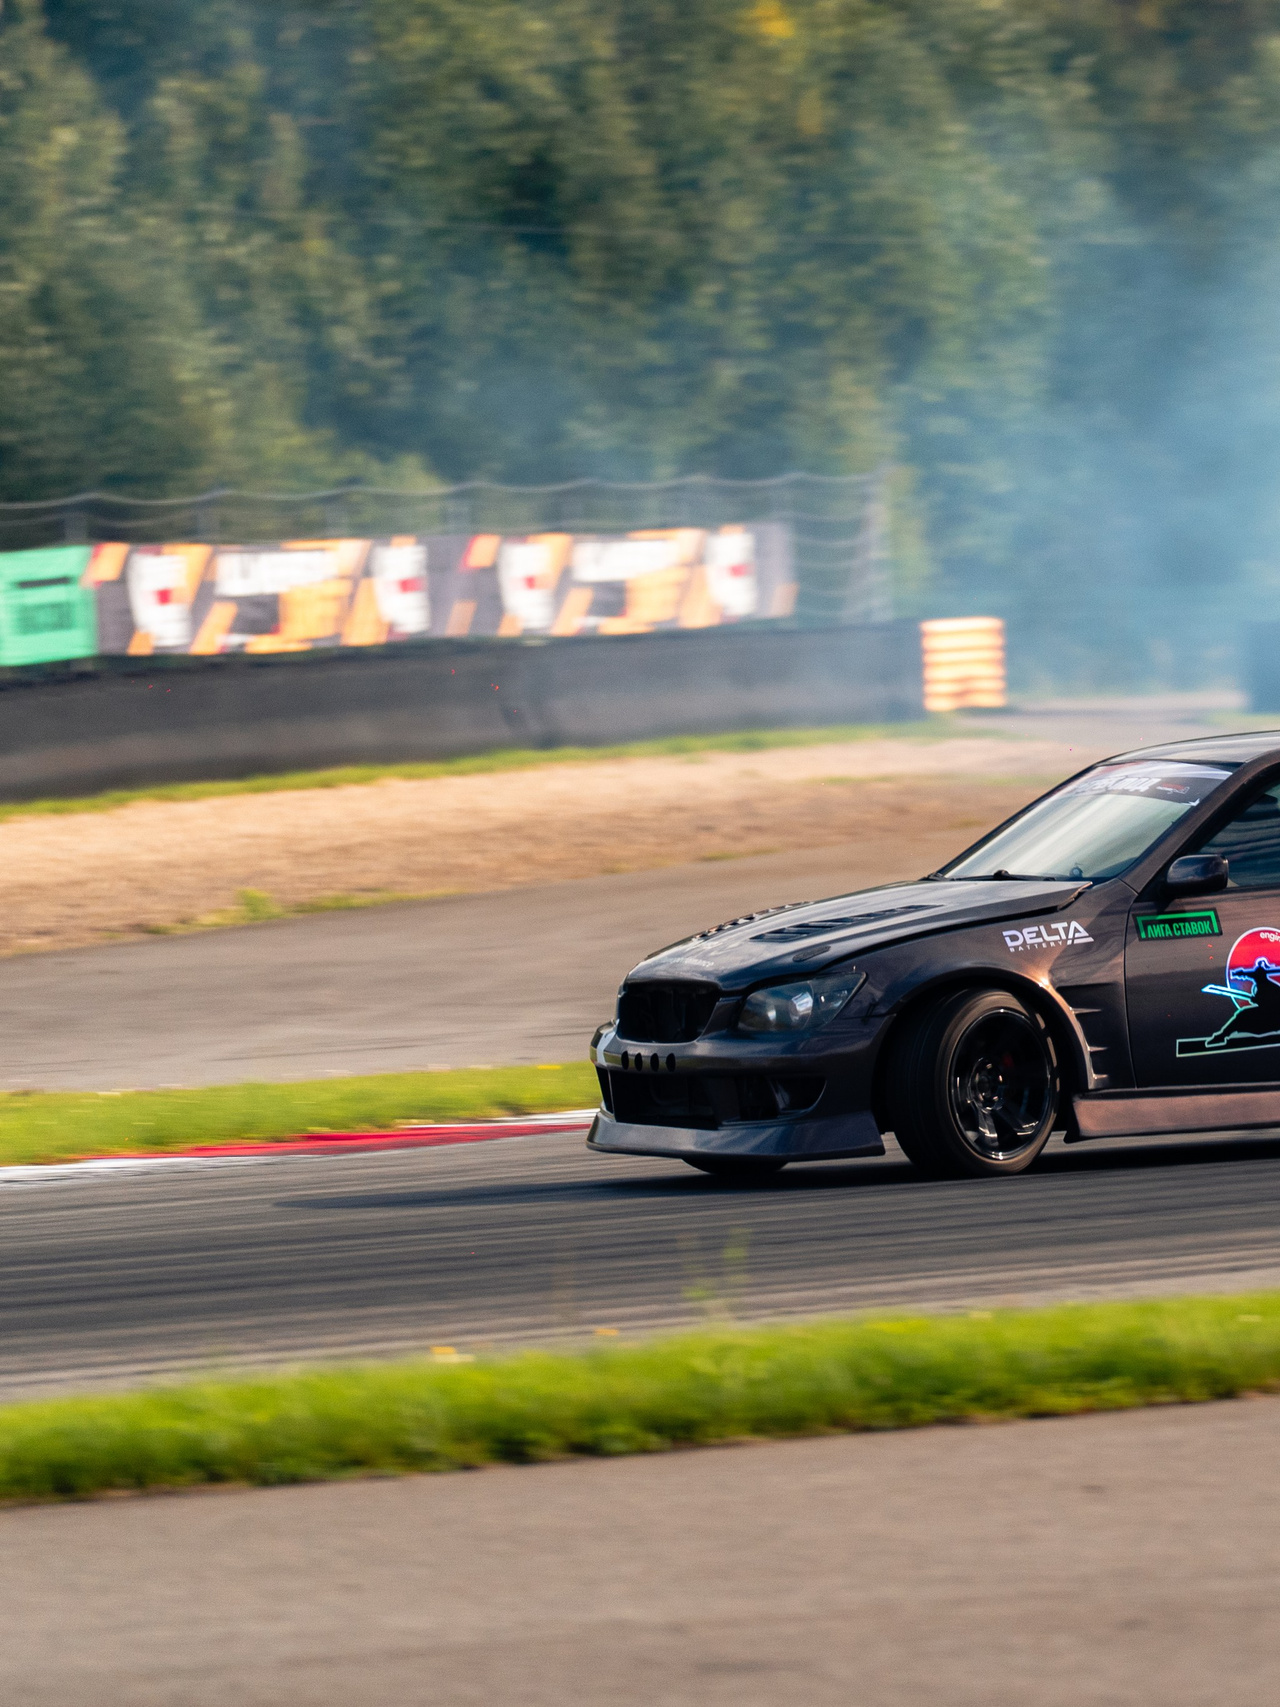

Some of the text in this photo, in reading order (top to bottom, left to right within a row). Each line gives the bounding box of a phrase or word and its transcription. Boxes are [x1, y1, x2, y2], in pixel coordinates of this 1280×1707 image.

[1002, 920, 1094, 947] DELTA
[1147, 920, 1212, 938] ЛИГА СТАВОК
[1009, 940, 1063, 952] BATTERY
